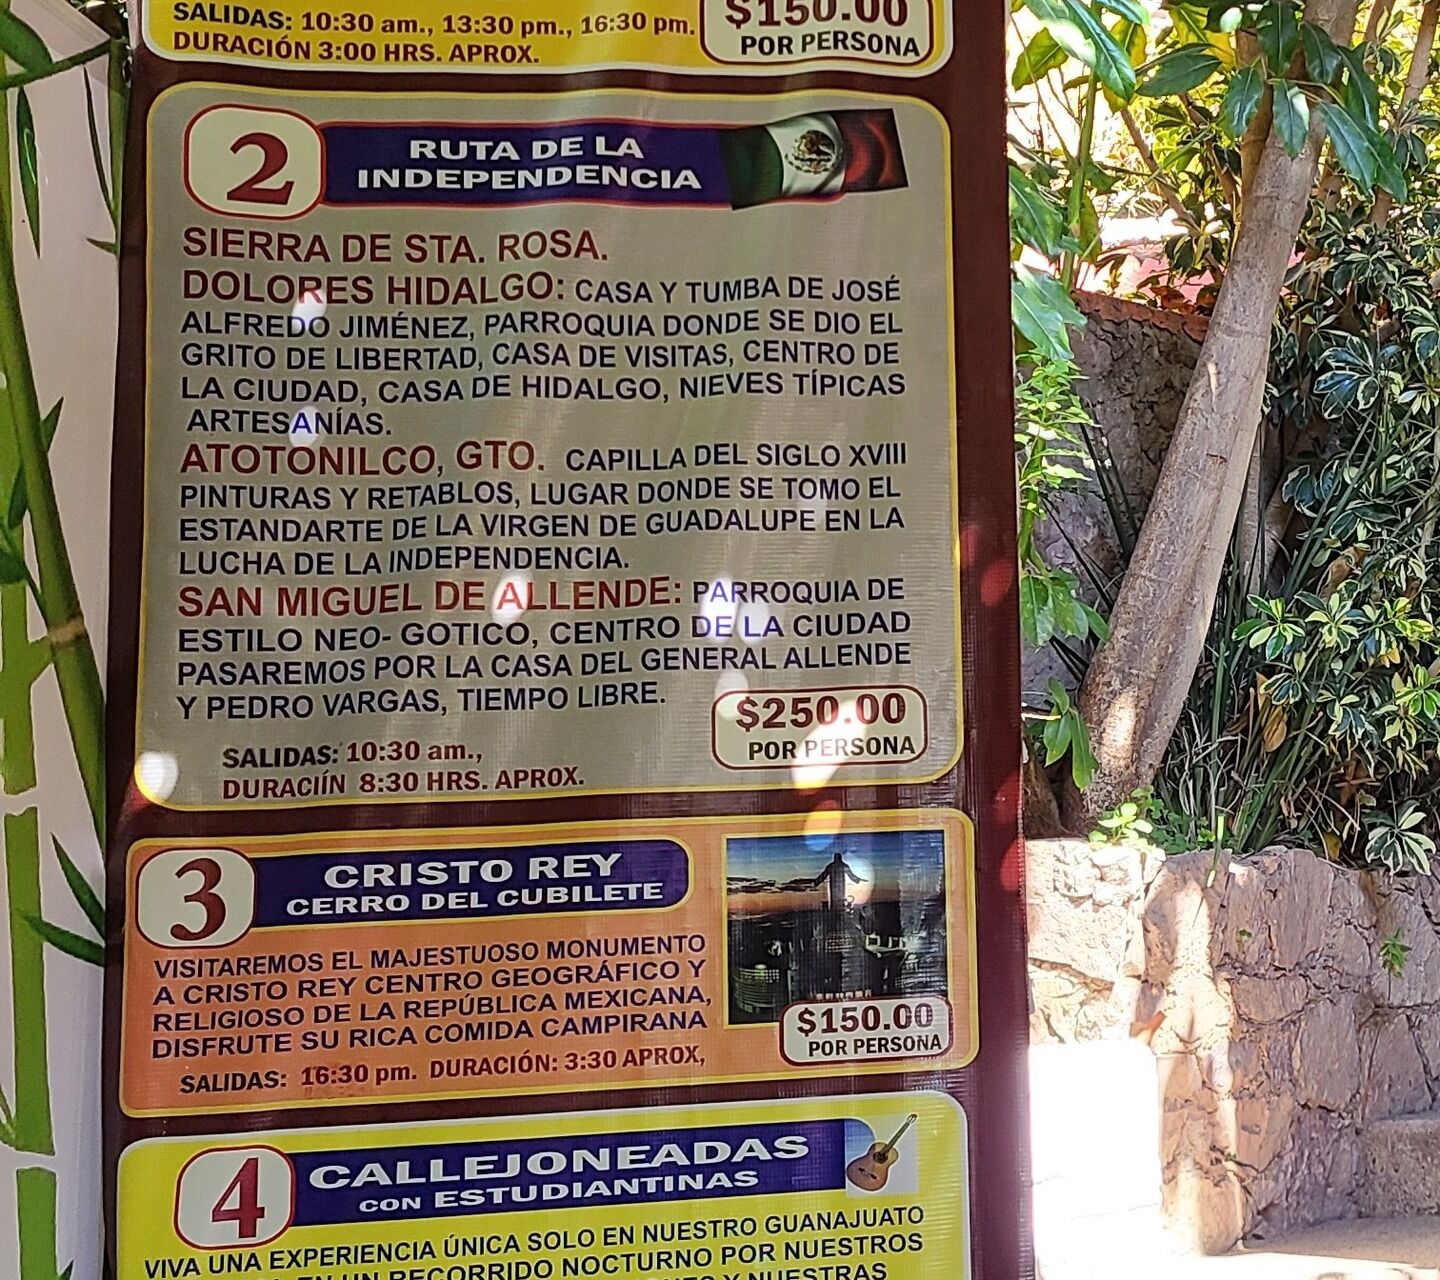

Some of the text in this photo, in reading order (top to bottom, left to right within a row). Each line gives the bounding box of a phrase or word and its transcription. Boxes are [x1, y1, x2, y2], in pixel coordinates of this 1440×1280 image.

[173, 2, 695, 39] SALIDAS: 10:30 am., 13:30 pm., 16:30 pm.
[173, 31, 540, 64] DURACIÓN 3:00 HRS. APROX.
[741, 30, 920, 56] POR PERSONA
[409, 136, 643, 160] RUTA DE LA
[227, 132, 295, 205] 2
[358, 165, 702, 190] INDEPENDENCIA
[183, 227, 608, 263] SIERRA DE STA. ROSA.
[183, 270, 901, 305] DOLORES HIDALGO: CASA Y TUMBA DE JOSÉ
[187, 408, 392, 435] ARTESANÍAS.
[180, 440, 907, 477] ATOTONILCO, GTO. CAPILLA DEL SIGLO XVIII
[179, 546, 629, 575] LUCHA DE LA INDEPENDENCIA.
[178, 576, 904, 617] SAN MIGUEL DE ALLENDE: PARROQUIA DE
[736, 692, 906, 732] $250.00
[222, 740, 482, 768] SALIDAS: 10:30 am.,
[749, 736, 915, 761] POR PERSONA
[359, 772, 418, 792] 8:30
[427, 770, 487, 792] HRS.
[495, 767, 584, 789] APROX.
[324, 853, 622, 888] CRISTO REY
[170, 857, 227, 941] 3
[286, 882, 663, 916] CERRO DEL CUBILETE
[154, 934, 706, 979] VISITAREMOS EL MAJESTUOSO MONUMENTO
[152, 1011, 707, 1059] DISFRUTE SU RICA COMIDA CAMPIRANA
[797, 1003, 934, 1037] $150.00
[808, 1034, 942, 1057] POR PERSONA
[180, 1070, 287, 1093] SALIDAS:
[301, 1064, 368, 1086] 16:30
[375, 1067, 417, 1086] pm.
[430, 1049, 558, 1079] DURACIÓN:
[564, 1050, 616, 1071] 3:30
[309, 1135, 810, 1189] CALLEJONEADAS
[211, 1157, 265, 1239] 4
[359, 1169, 760, 1212] CON ESTUDIANTINAS
[145, 1205, 925, 1279] VIVA UNA EXPERIENCIA ÚNICA SOLO EN NUESTRO GUANAJUATO
